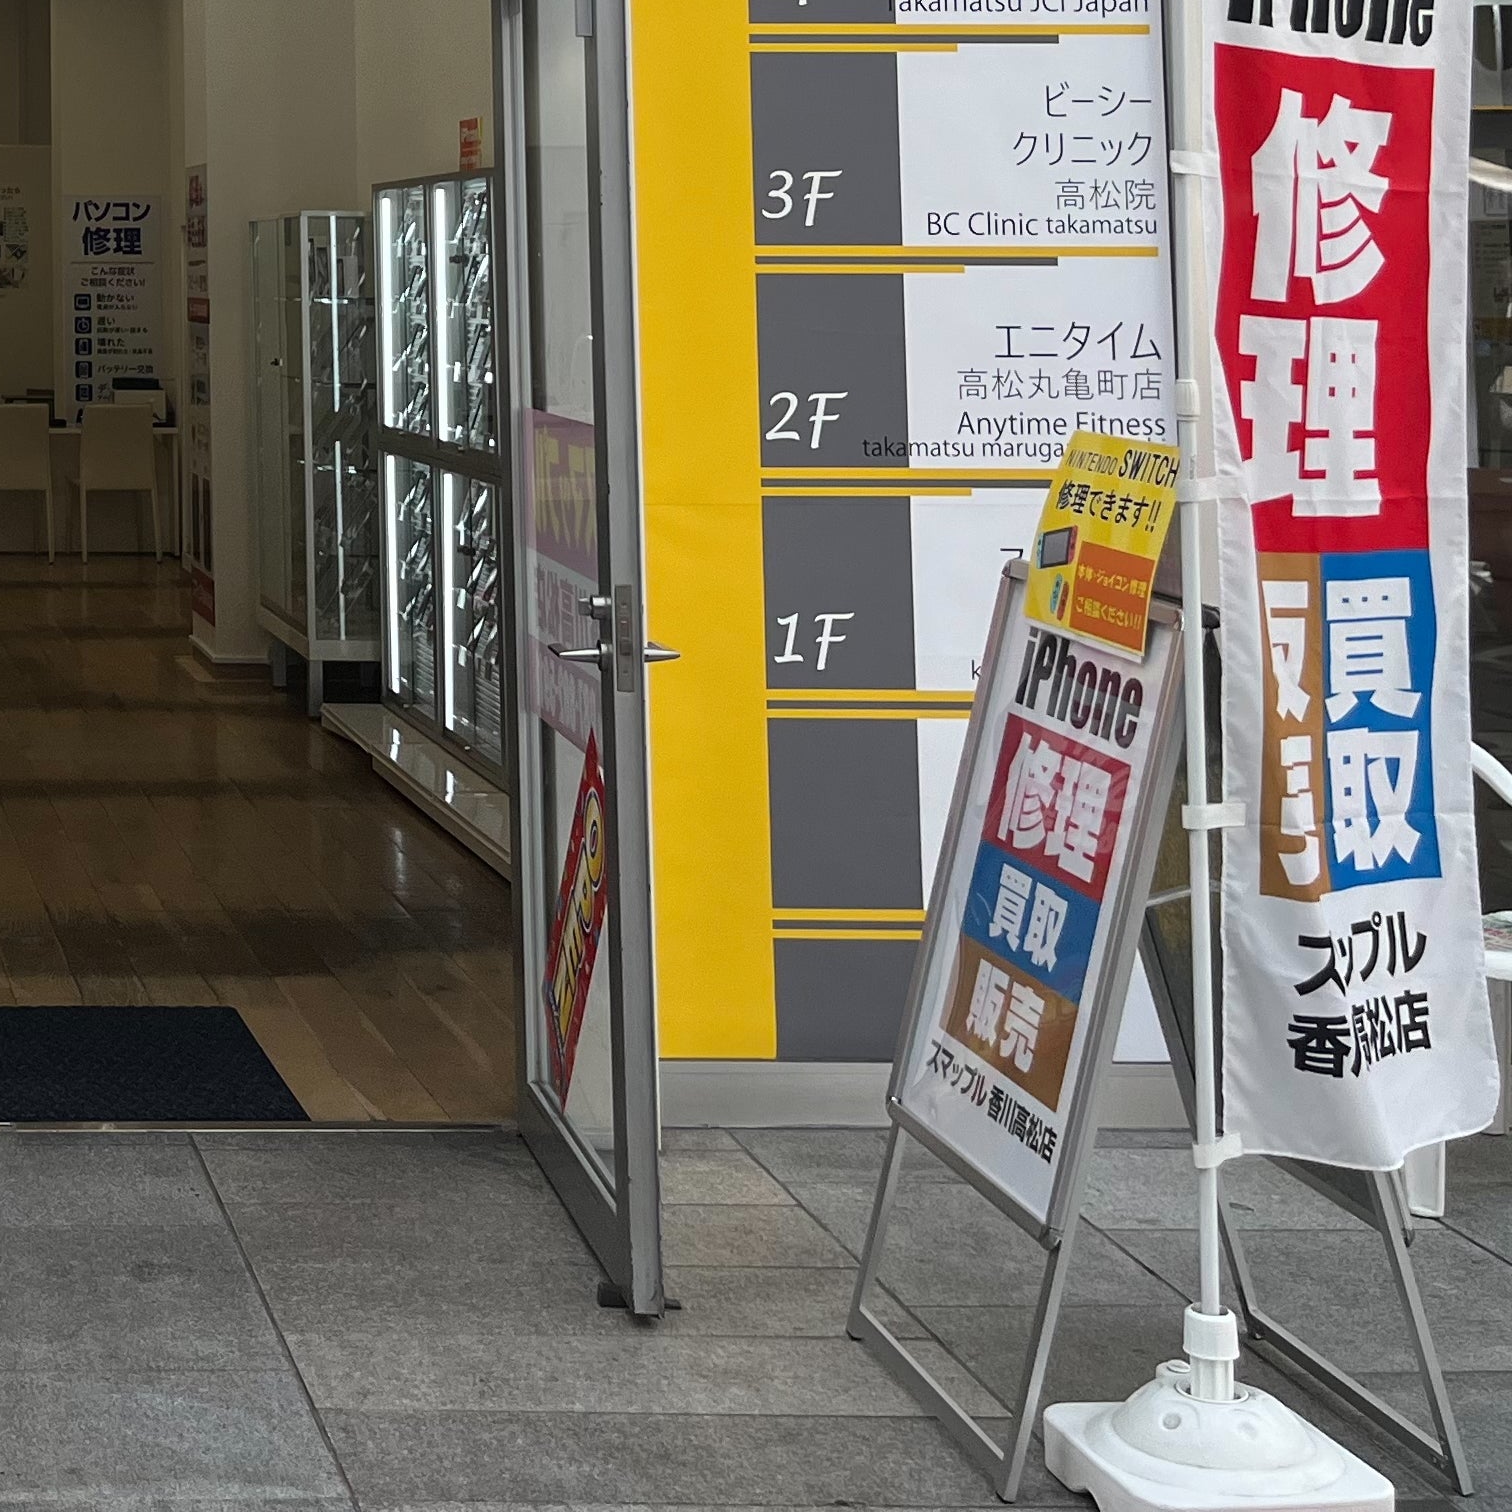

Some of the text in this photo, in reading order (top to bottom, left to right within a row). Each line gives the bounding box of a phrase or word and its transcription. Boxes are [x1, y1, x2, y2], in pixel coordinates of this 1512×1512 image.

[1044, 81, 1153, 119] ビーシー
[1012, 131, 1153, 167] クリニック
[72, 199, 151, 223] パソコン
[760, 168, 844, 227] 3F
[1054, 178, 1157, 212] 高松院
[81, 226, 143, 256] 修理
[927, 210, 1158, 237] BC Clinic takamatsu
[1239, 86, 1393, 518] 修理
[994, 321, 1163, 362] エニタイム
[956, 367, 1163, 401] 高松丸亀町店
[764, 390, 849, 450] 2F
[956, 410, 1166, 442] Anytime Fitness
[862, 436, 976, 459] takamatsu
[1066, 448, 1181, 489] NINTENDO SWITCH
[1055, 478, 1162, 533] 修理できます!!
[773, 611, 855, 671] 1F
[1015, 625, 1145, 750] iPhone
[1324, 576, 1422, 872] 買取
[996, 731, 1115, 885] 修理
[987, 862, 1070, 974] 買取
[964, 958, 1046, 1075] 販売
[926, 1039, 1058, 1165] スマップル 香川高松店
